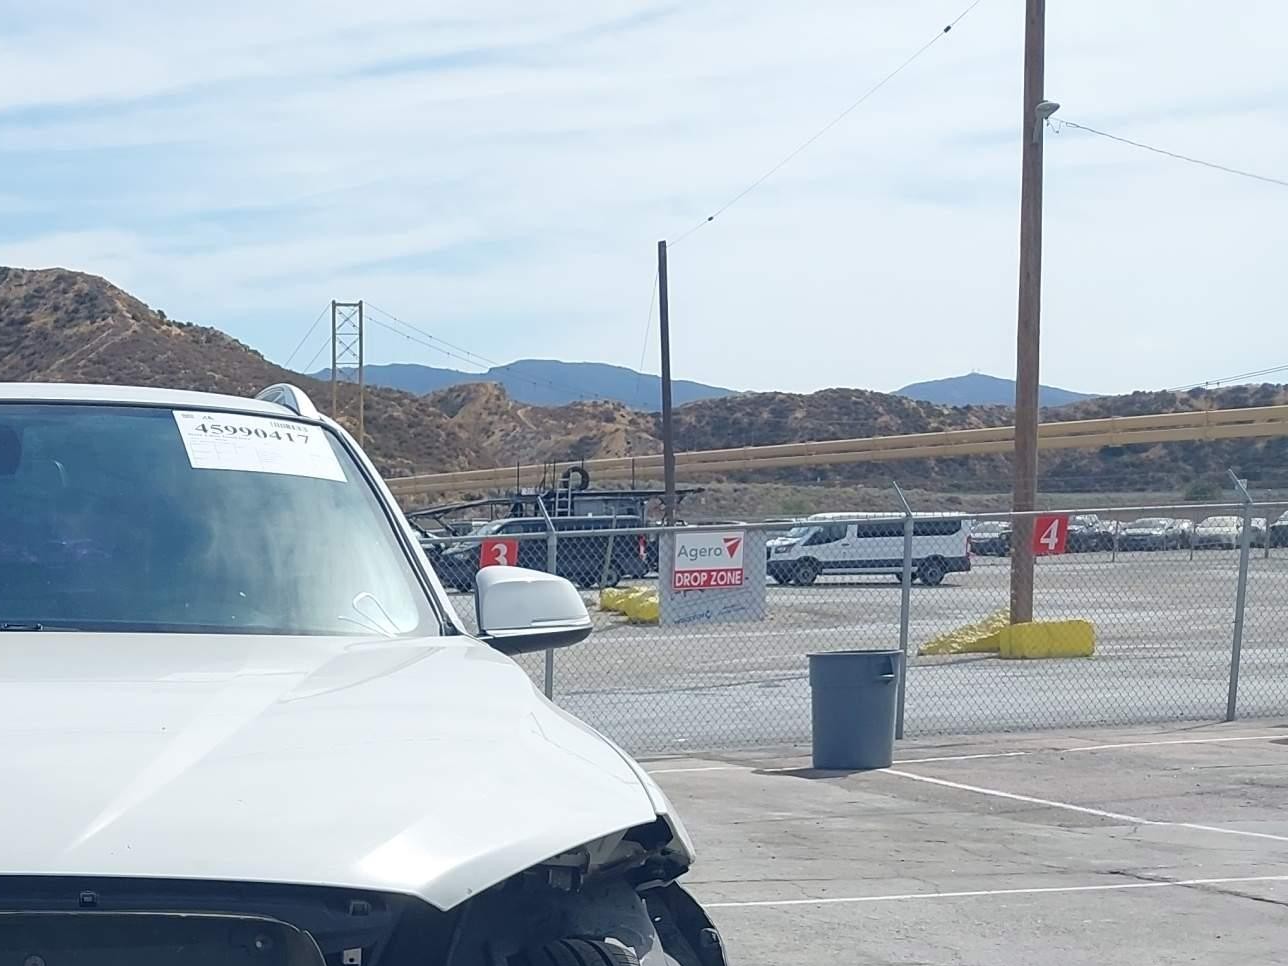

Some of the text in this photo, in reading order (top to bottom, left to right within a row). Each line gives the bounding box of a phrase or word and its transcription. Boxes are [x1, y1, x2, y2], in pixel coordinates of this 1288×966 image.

[195, 423, 309, 444] 45990417
[1039, 519, 1059, 550] 4
[491, 543, 508, 566] 3
[677, 545, 722, 561] Agero
[675, 570, 742, 587] DROP ZONE
